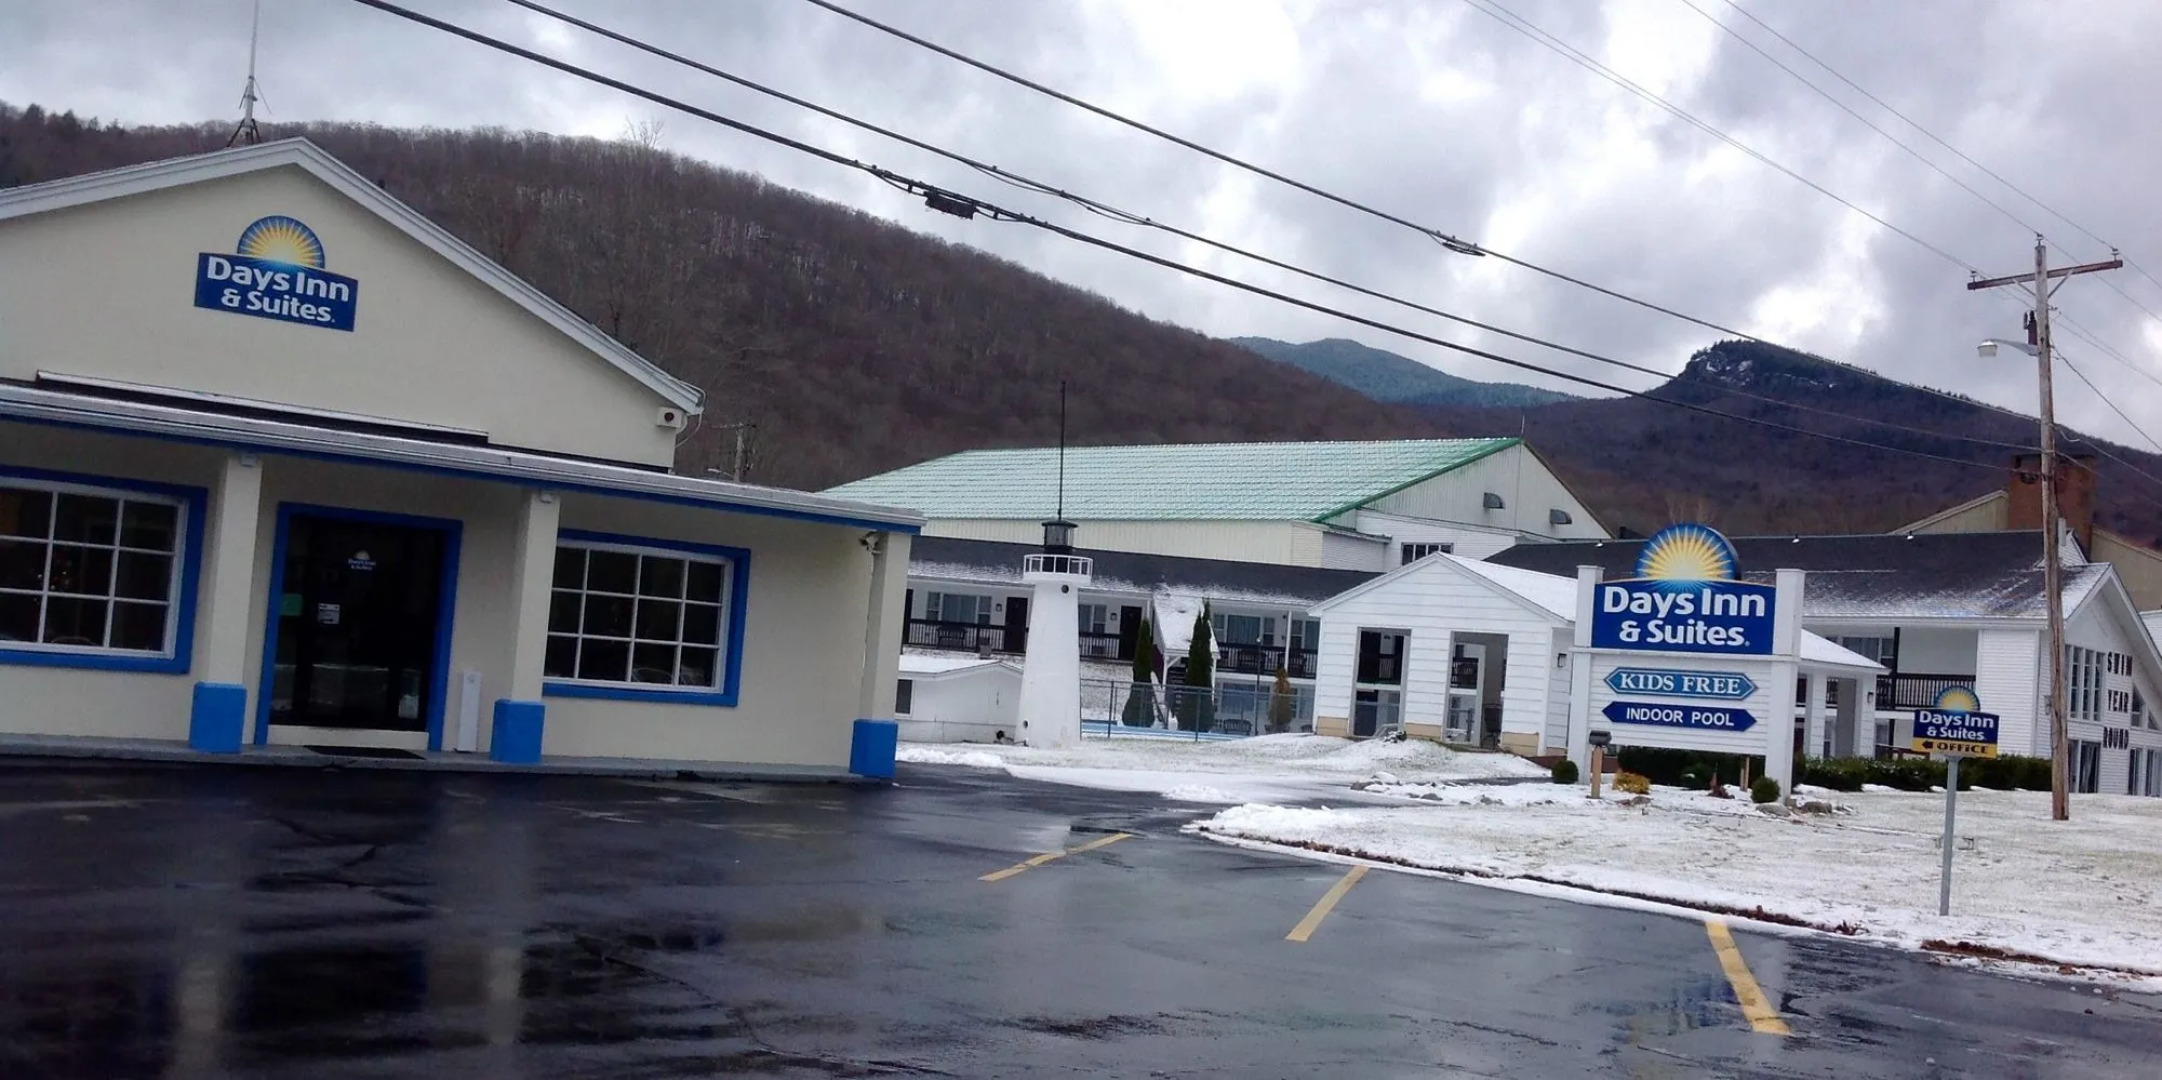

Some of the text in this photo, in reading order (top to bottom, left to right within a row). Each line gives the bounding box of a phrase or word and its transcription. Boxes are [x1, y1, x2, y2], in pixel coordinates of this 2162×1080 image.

[207, 256, 349, 302] Days Inn
[221, 288, 241, 307] &
[1604, 586, 1765, 618] Days Inn
[1619, 621, 1641, 642] &
[2107, 652, 2133, 676] SWIM
[1620, 673, 1741, 694] KIDS FREE
[2108, 690, 2129, 713] YEAR
[1626, 707, 1735, 726] INDOOR POOL
[1920, 711, 1994, 728] Days Inn
[1927, 726, 1937, 736] &
[2103, 727, 2129, 750] ROUND
